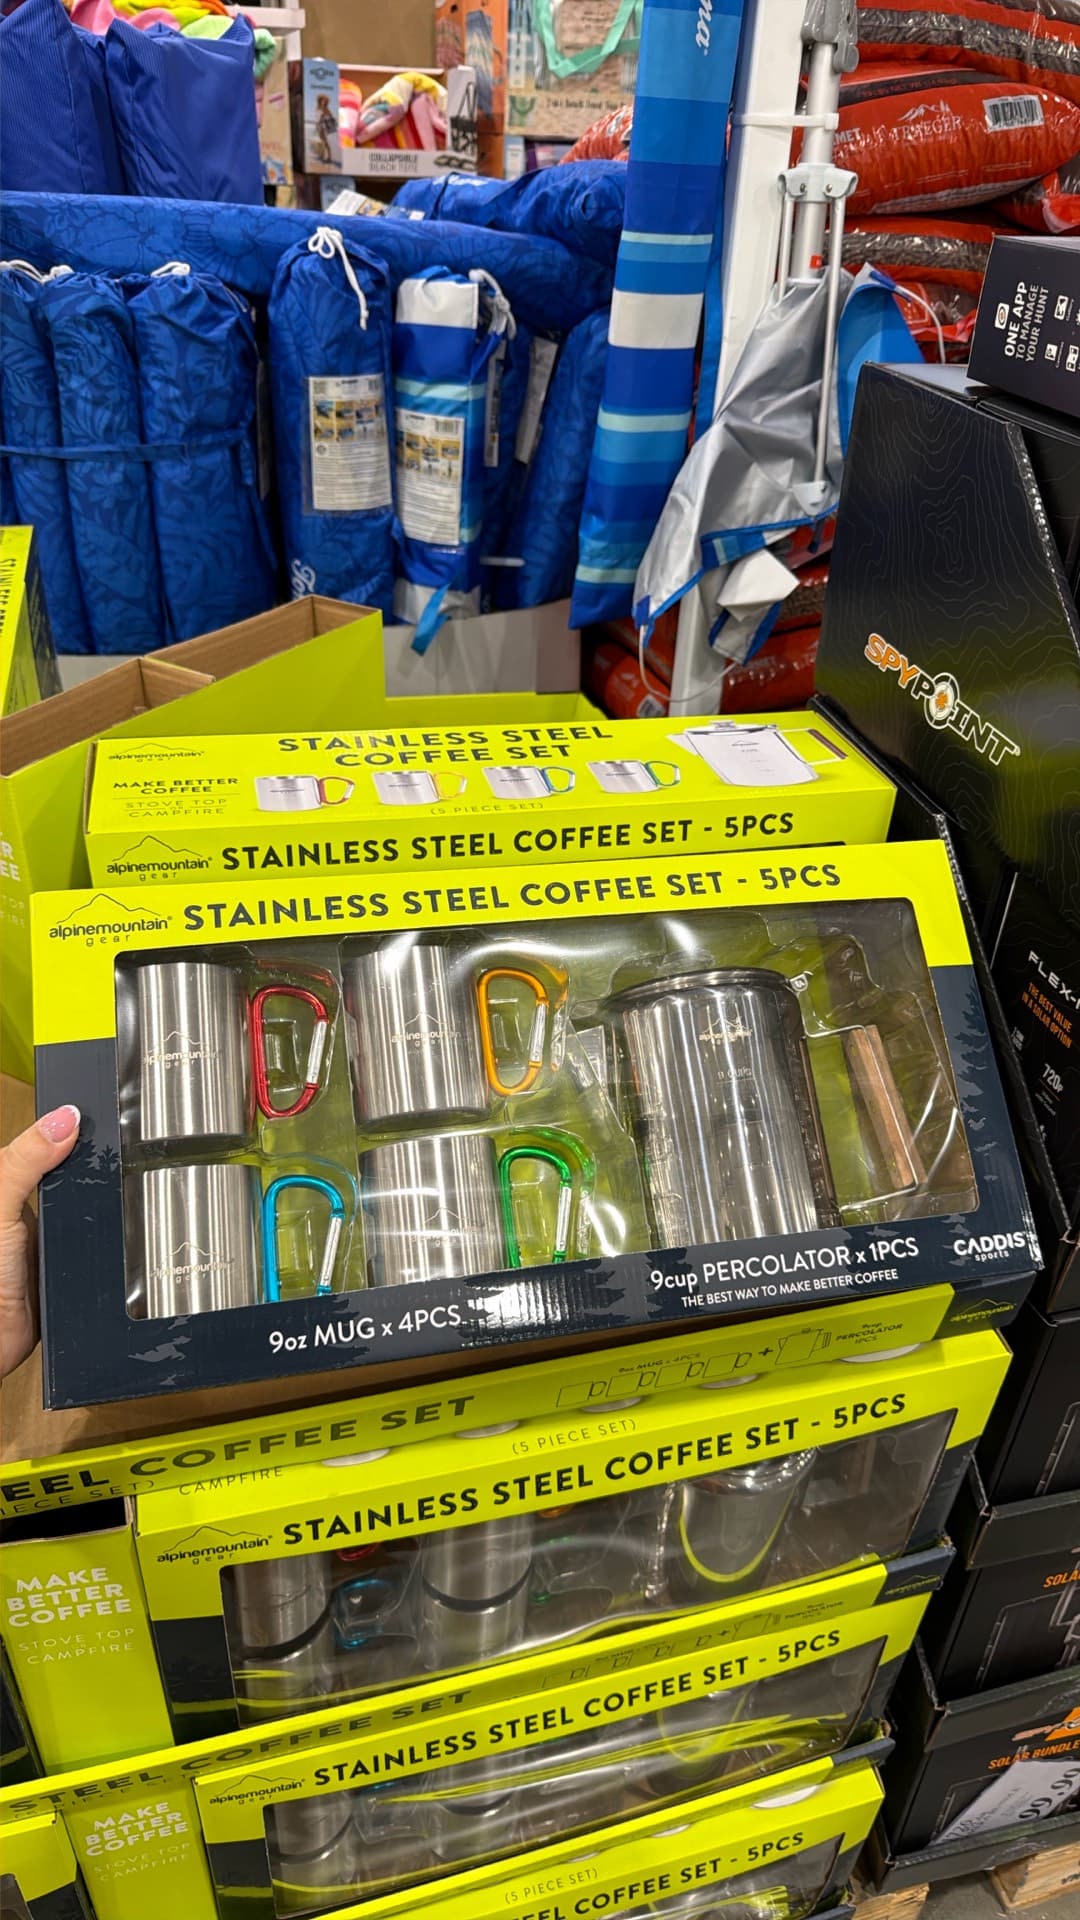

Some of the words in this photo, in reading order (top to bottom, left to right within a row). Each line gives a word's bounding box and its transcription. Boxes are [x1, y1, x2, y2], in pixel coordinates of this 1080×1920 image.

[1012, 281, 1028, 319] APP
[1015, 344, 1027, 360] TO
[1021, 284, 1039, 341] MANAGE
[1025, 326, 1041, 363] YOUR
[1034, 286, 1049, 325] HUNT
[1004, 321, 1021, 357] ONE
[864, 633, 1020, 766] SPYPOINT
[277, 731, 490, 753] STAINLESS
[500, 726, 613, 743] STEEL
[334, 748, 493, 768] COFFEE
[506, 744, 571, 760] SET
[113, 780, 166, 789] MAKE
[173, 777, 239, 787] BETTER
[140, 785, 212, 795] COFFEE
[125, 800, 184, 809] STOVE
[193, 798, 228, 806] TOP
[128, 808, 225, 818] CAMPFIRE
[454, 803, 502, 813] PIECE
[511, 802, 544, 811] SET)
[222, 838, 399, 871] STAINLESS
[411, 831, 503, 859] STEEL
[513, 822, 632, 853] COFFEE
[642, 819, 693, 845] SET
[725, 812, 795, 838] 5PCS
[106, 857, 212, 876] alpinemountain
[139, 871, 178, 882] gear
[183, 892, 390, 931] STAINLESS
[403, 886, 510, 915] STEEL
[520, 875, 656, 906] COFFEE
[667, 871, 724, 897] SET
[759, 864, 841, 891] 5PCS
[48, 915, 173, 940] alpinemountain
[85, 933, 131, 947] gear
[1032, 1003, 1051, 1028] SOLAR
[1049, 1021, 1073, 1049] OPTION
[1053, 1008, 1073, 1033] VALUE
[953, 1232, 1027, 1256] CADDIS
[974, 1250, 1010, 1263] sports
[650, 1269, 698, 1294] 9cup
[702, 1244, 851, 1284] PERCOLATOR
[855, 1251, 867, 1264] x
[869, 1237, 920, 1262] 1PCS
[681, 1294, 705, 1309] THE
[706, 1289, 735, 1306] BEST
[735, 1286, 761, 1302] WAY
[761, 1284, 778, 1299] TO
[779, 1280, 813, 1297] MAKE
[813, 1275, 854, 1292] BETTER
[854, 1269, 900, 1286] COFFEE
[268, 1330, 308, 1354] 9oz
[314, 1317, 376, 1346] MUG
[381, 1322, 393, 1337] x
[398, 1304, 462, 1334] 4PCS
[835, 1322, 904, 1342] PERCOLATOR
[636, 1359, 663, 1371] MUG
[129, 1419, 358, 1478] COFFEE
[381, 1395, 476, 1432] SET
[511, 1439, 530, 1456] (5
[537, 1427, 592, 1451] PIECE
[599, 1417, 638, 1437] SET)
[178, 1465, 285, 1497] CAMPFIRE
[283, 1487, 480, 1547] STAINLESS
[492, 1463, 594, 1506] STEEL
[604, 1431, 734, 1482] COFFEE
[745, 1416, 800, 1451] SET
[833, 1392, 907, 1430] 5PCS
[88, 1480, 154, 1500] SET)
[156, 1535, 273, 1565] alpinemountain
[191, 1552, 235, 1567] gear
[16, 1567, 110, 1594] MAKE
[6, 1583, 125, 1612] BETTER
[8, 1598, 133, 1628] COFFEE
[18, 1634, 86, 1652] STOVE
[96, 1627, 136, 1640] TOP
[26, 1642, 134, 1666] CAMPFIRE
[313, 1730, 479, 1787] STAINLESS
[488, 1706, 575, 1745] STEEL
[582, 1671, 693, 1720] COFFEE
[703, 1655, 750, 1686] SET
[777, 1629, 841, 1664] 5PCS
[9, 1772, 164, 1814] STEEL
[181, 1714, 374, 1772] COFFEE
[391, 1690, 473, 1721] SET
[988, 1751, 1031, 1769] SOLAR
[1032, 1739, 1080, 1759] BUNDLE
[209, 1778, 306, 1806] alpinemountain
[85, 1812, 183, 1846] BETTER
[93, 1801, 171, 1832] MAKE
[86, 1822, 189, 1857] COFFEE
[504, 1892, 518, 1905] (5
[523, 1877, 565, 1899] PIECE
[569, 1867, 599, 1885] SET)
[574, 1873, 671, 1916] COFFEE
[679, 1857, 721, 1883] SET
[747, 1831, 806, 1861] 5PCS
